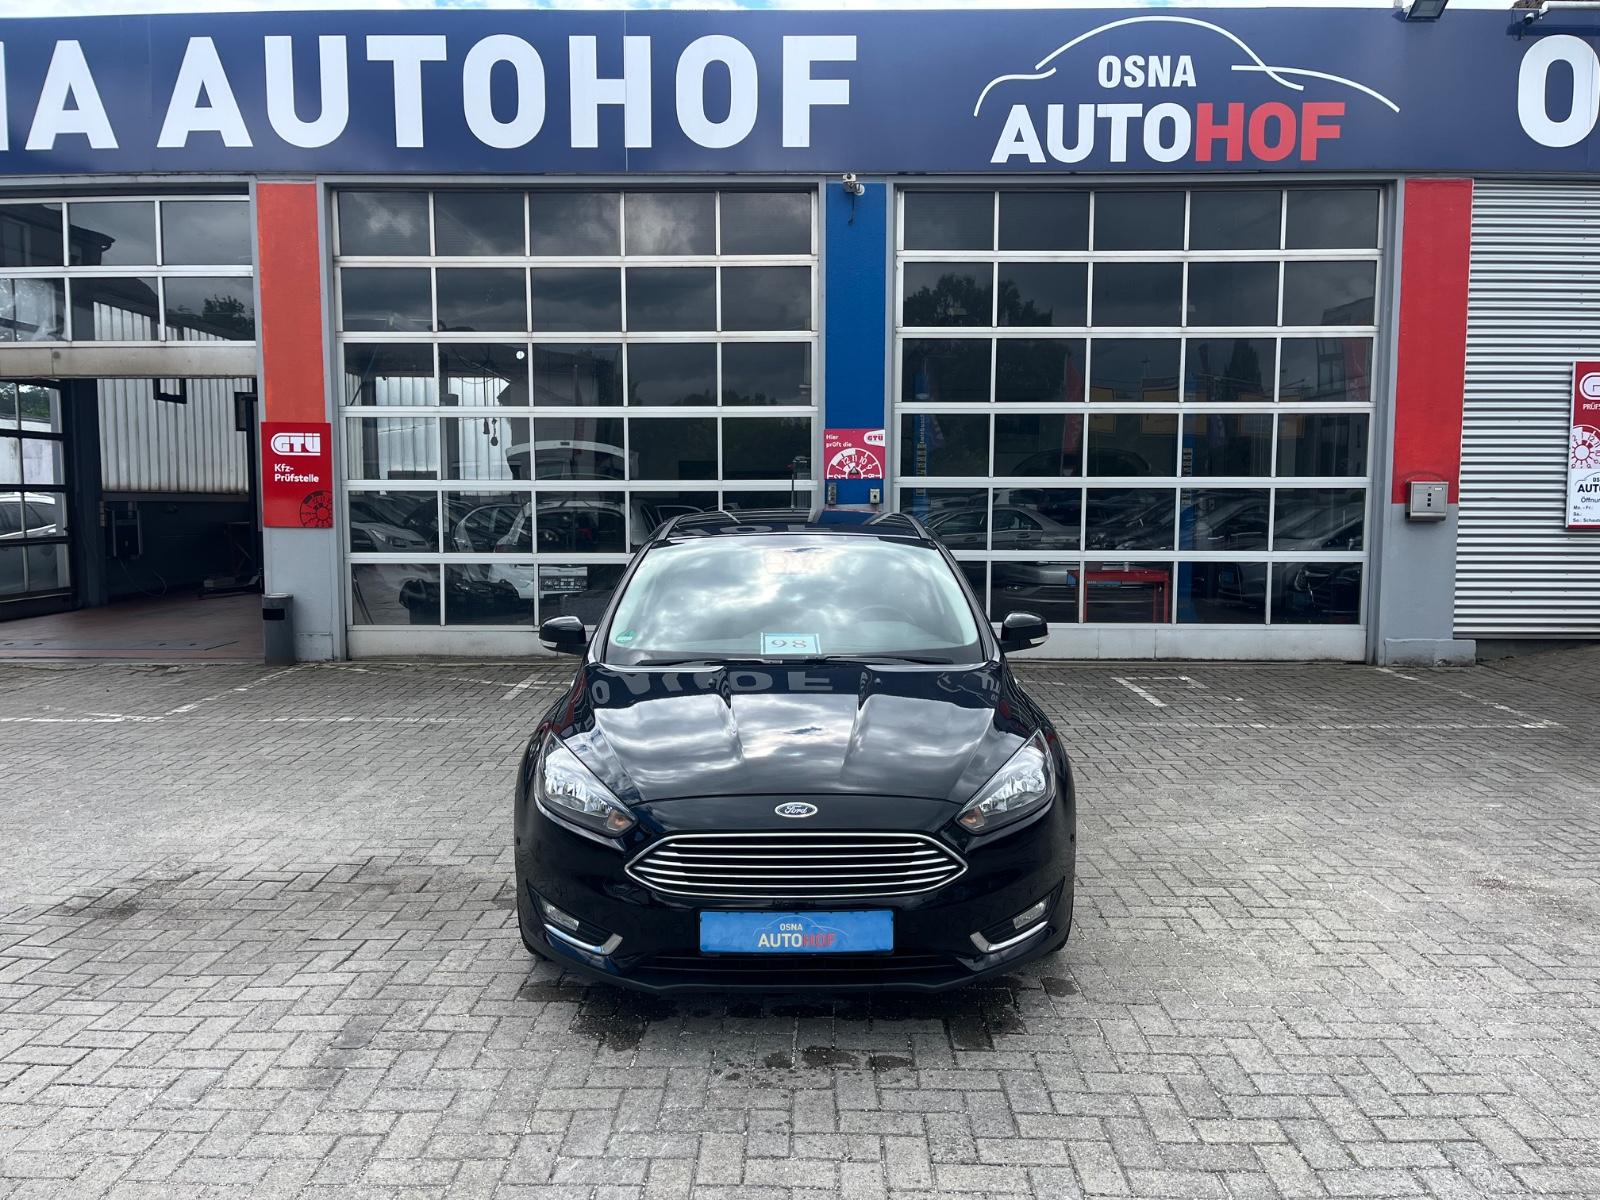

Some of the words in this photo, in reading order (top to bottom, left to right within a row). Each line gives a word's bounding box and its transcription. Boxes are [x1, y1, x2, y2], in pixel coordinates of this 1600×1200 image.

[1098, 54, 1196, 88] OSNA
[0, 40, 119, 150] A
[156, 34, 857, 149] AUTOHOF
[990, 101, 1345, 164] AUTOHOF
[271, 433, 320, 456] GTÜ
[274, 463, 294, 472] Kfz-
[274, 473, 319, 483] Prüfstelle
[1577, 484, 1600, 493] AUT
[771, 639, 807, 649] 98
[784, 805, 809, 814] Ford
[780, 923, 803, 931] OSNA
[758, 933, 836, 948] AUTOHOF
